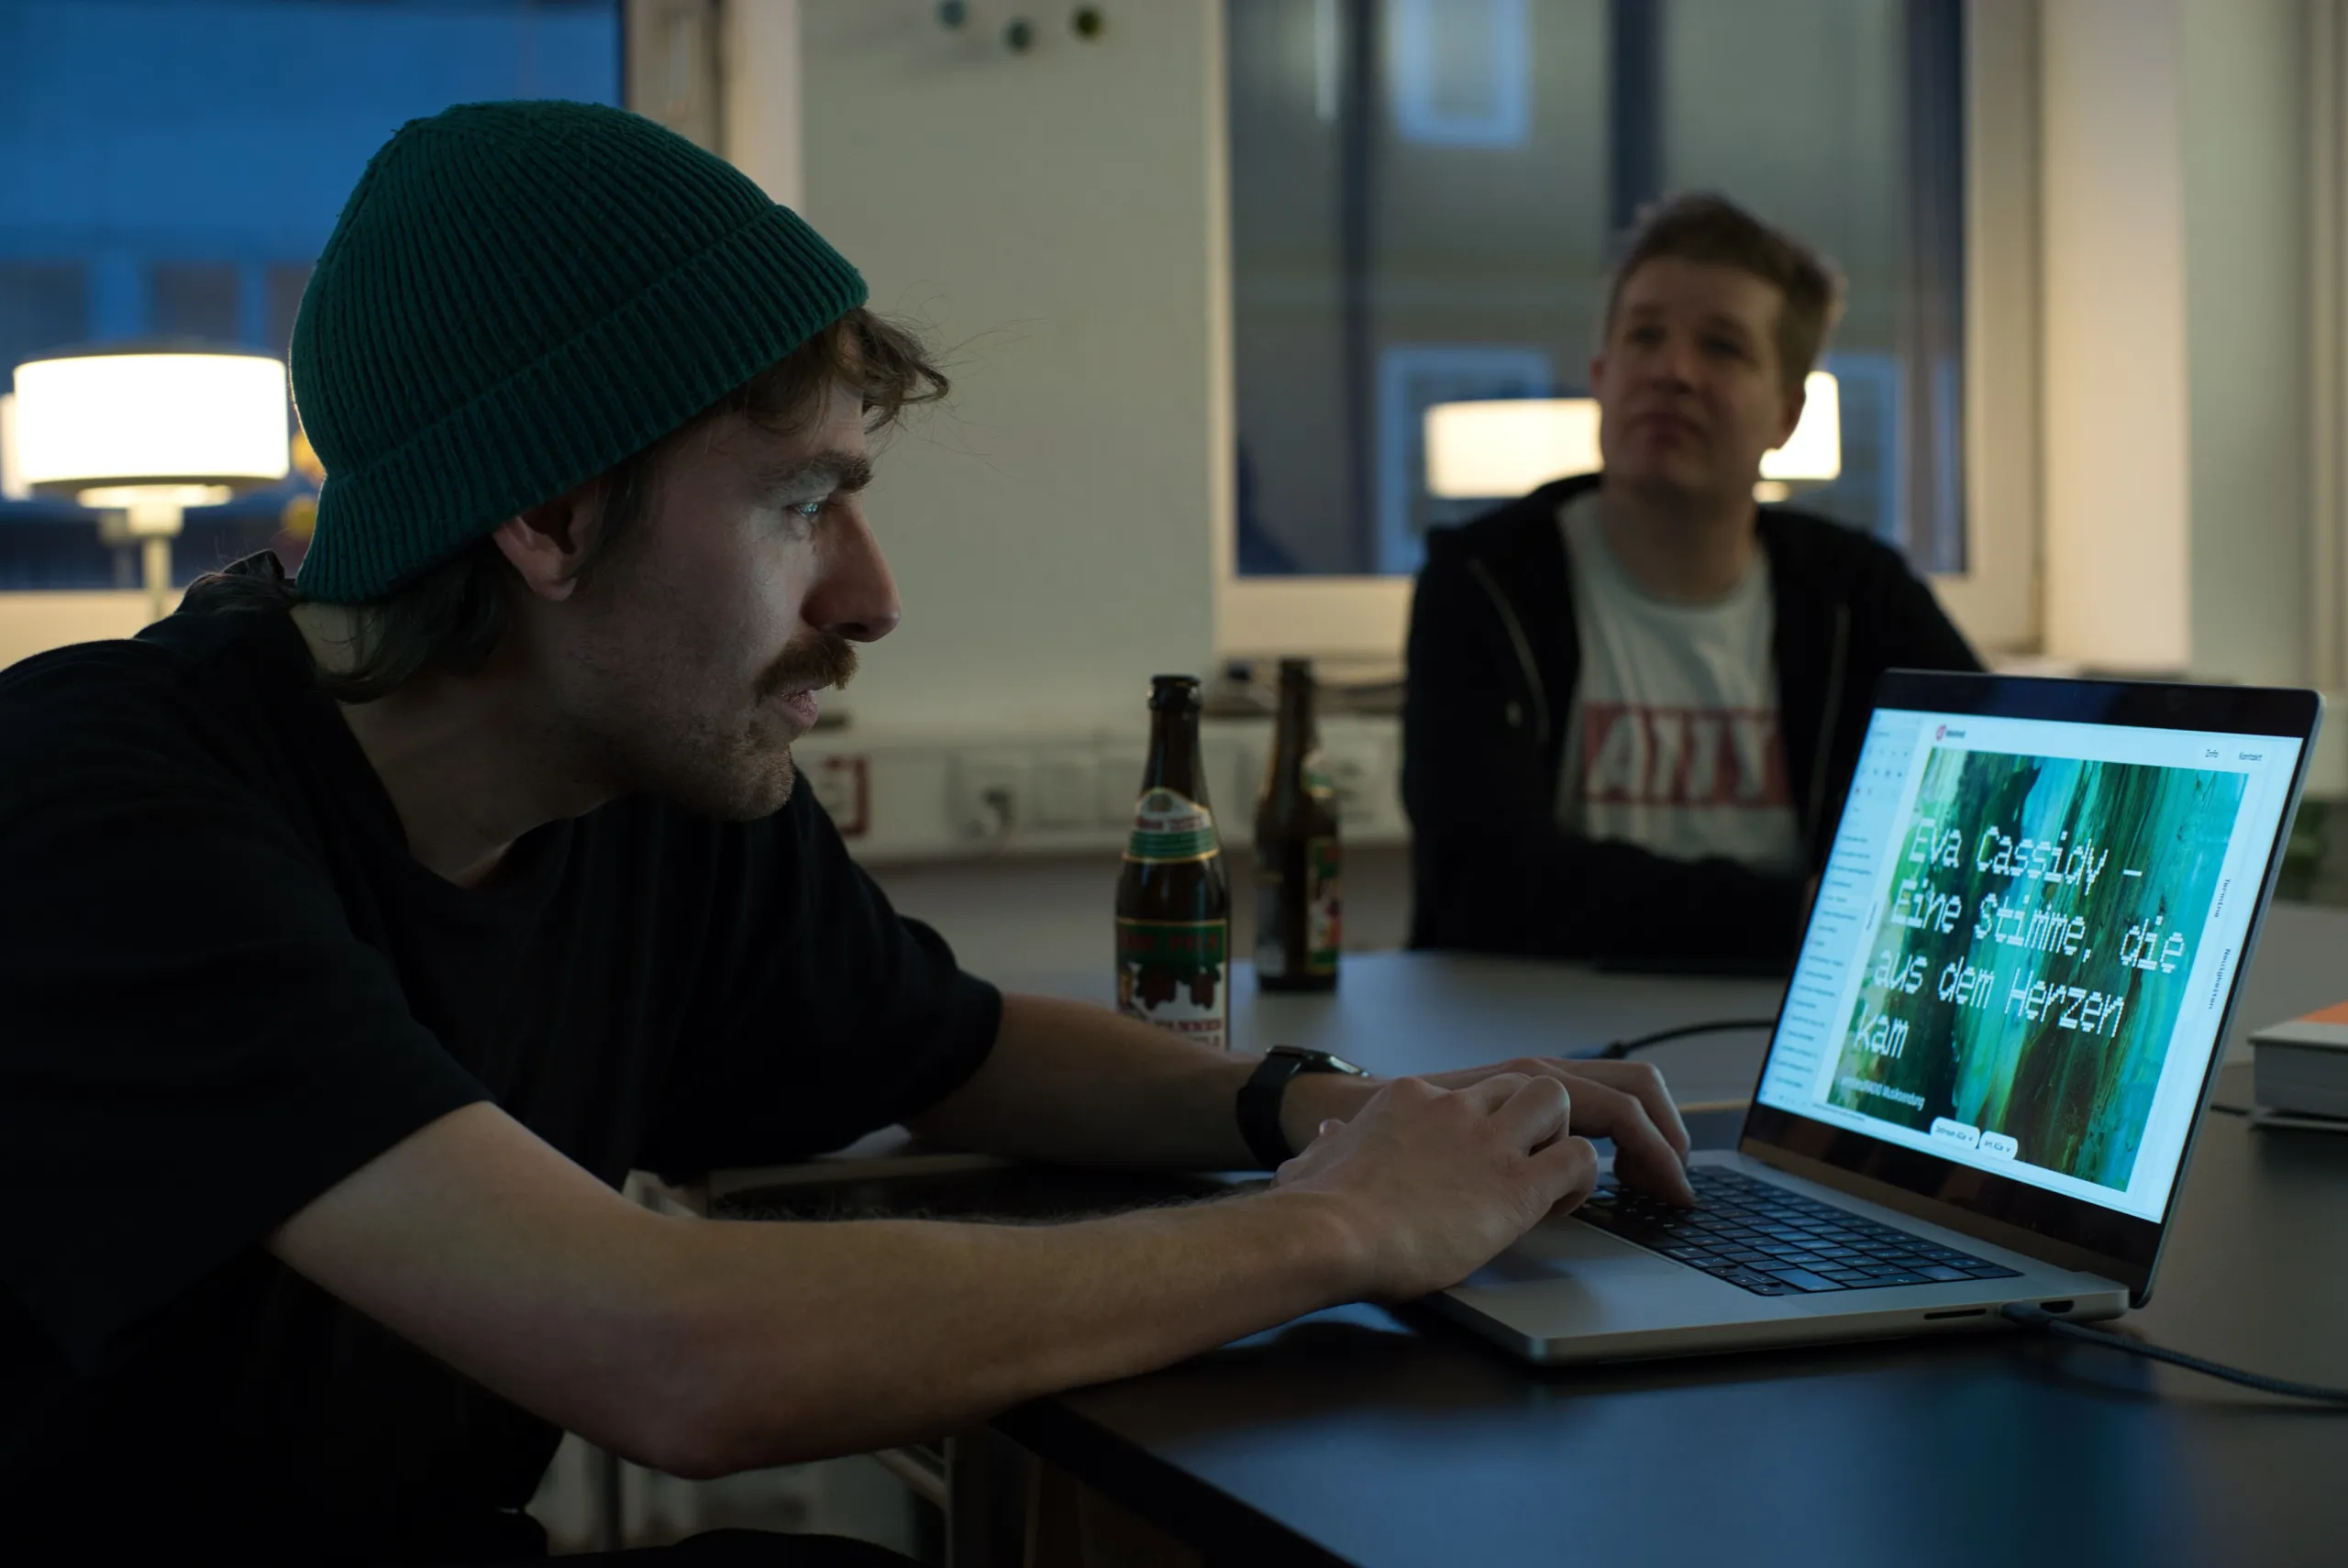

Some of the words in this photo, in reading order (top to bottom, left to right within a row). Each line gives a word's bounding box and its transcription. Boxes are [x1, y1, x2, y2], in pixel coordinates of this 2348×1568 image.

[2205, 748, 2219, 758] Info
[2239, 751, 2263, 762] Kontakt
[1909, 818, 1962, 868] Eva
[1977, 826, 2109, 896] Cassidy
[1890, 878, 1962, 933] Eine
[1975, 892, 2091, 963] Stimme,
[2120, 914, 2185, 974] die
[2213, 878, 2231, 918] Termine
[1873, 950, 1927, 995] aus
[1938, 955, 1995, 1010] dem
[2005, 967, 2125, 1038] Herzen
[2209, 948, 2232, 1010] Neuigkeiten
[1853, 1003, 1909, 1059] kam
